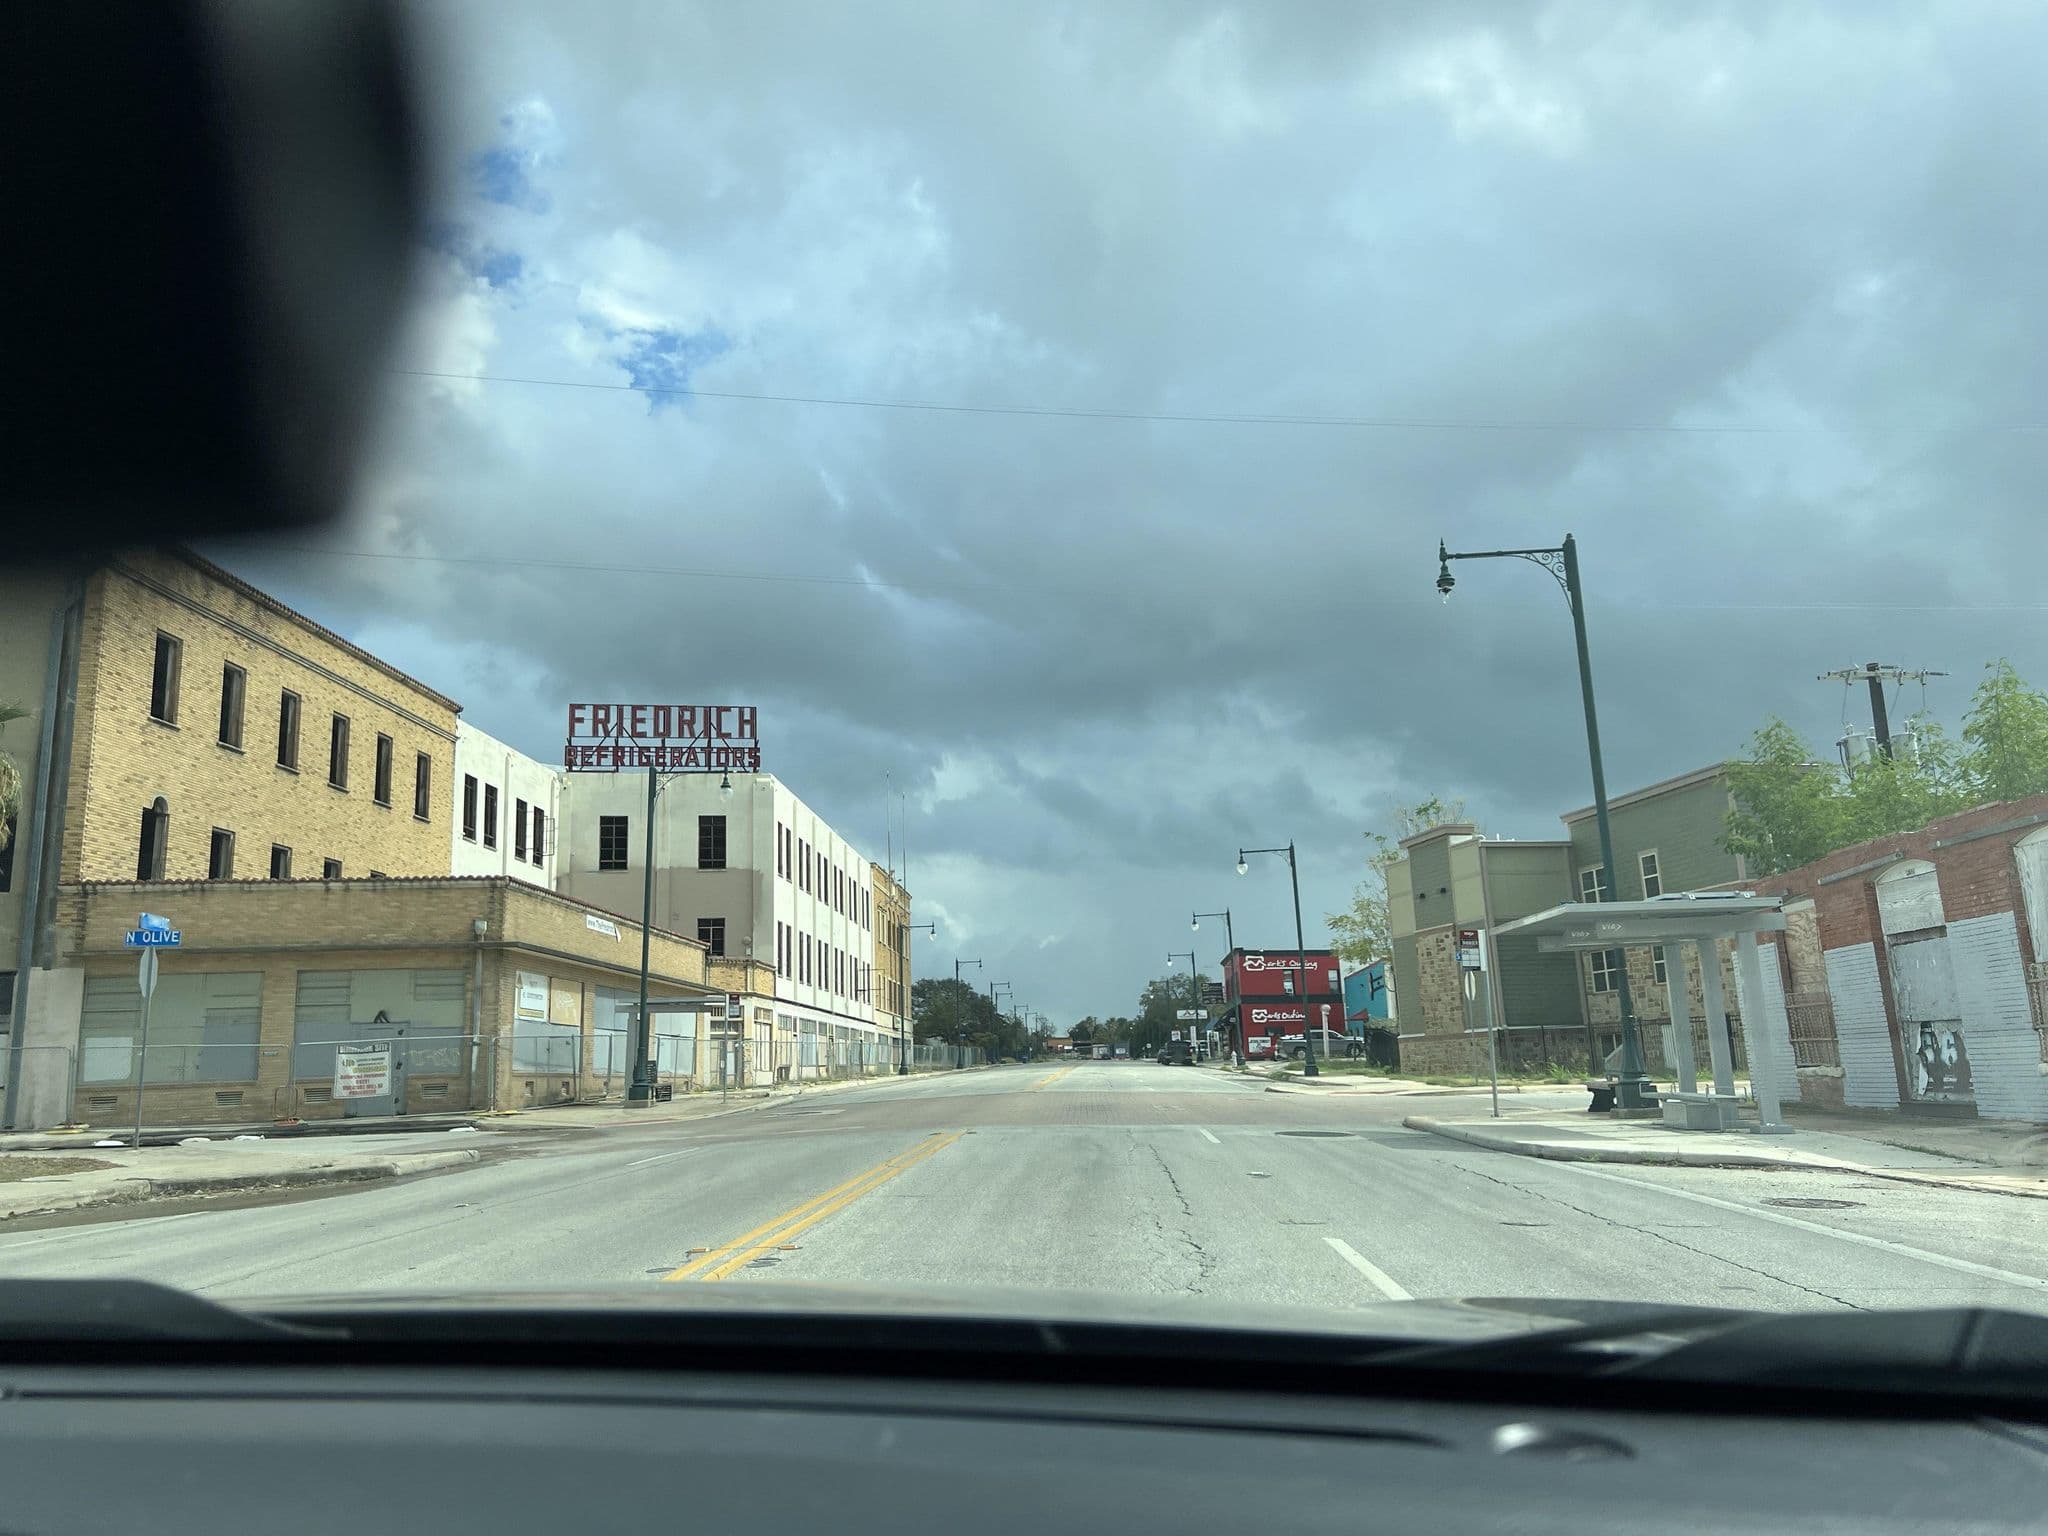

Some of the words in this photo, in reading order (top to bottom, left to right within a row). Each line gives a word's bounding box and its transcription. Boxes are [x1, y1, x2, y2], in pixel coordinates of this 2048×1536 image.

[569, 704, 757, 738] FRIEDRICH
[565, 746, 760, 768] REFRIGERATORS
[127, 931, 136, 943] N
[142, 931, 179, 943] OLIVE
[1289, 960, 1318, 970] Ouing
[1281, 1009, 1305, 1019] Outin
